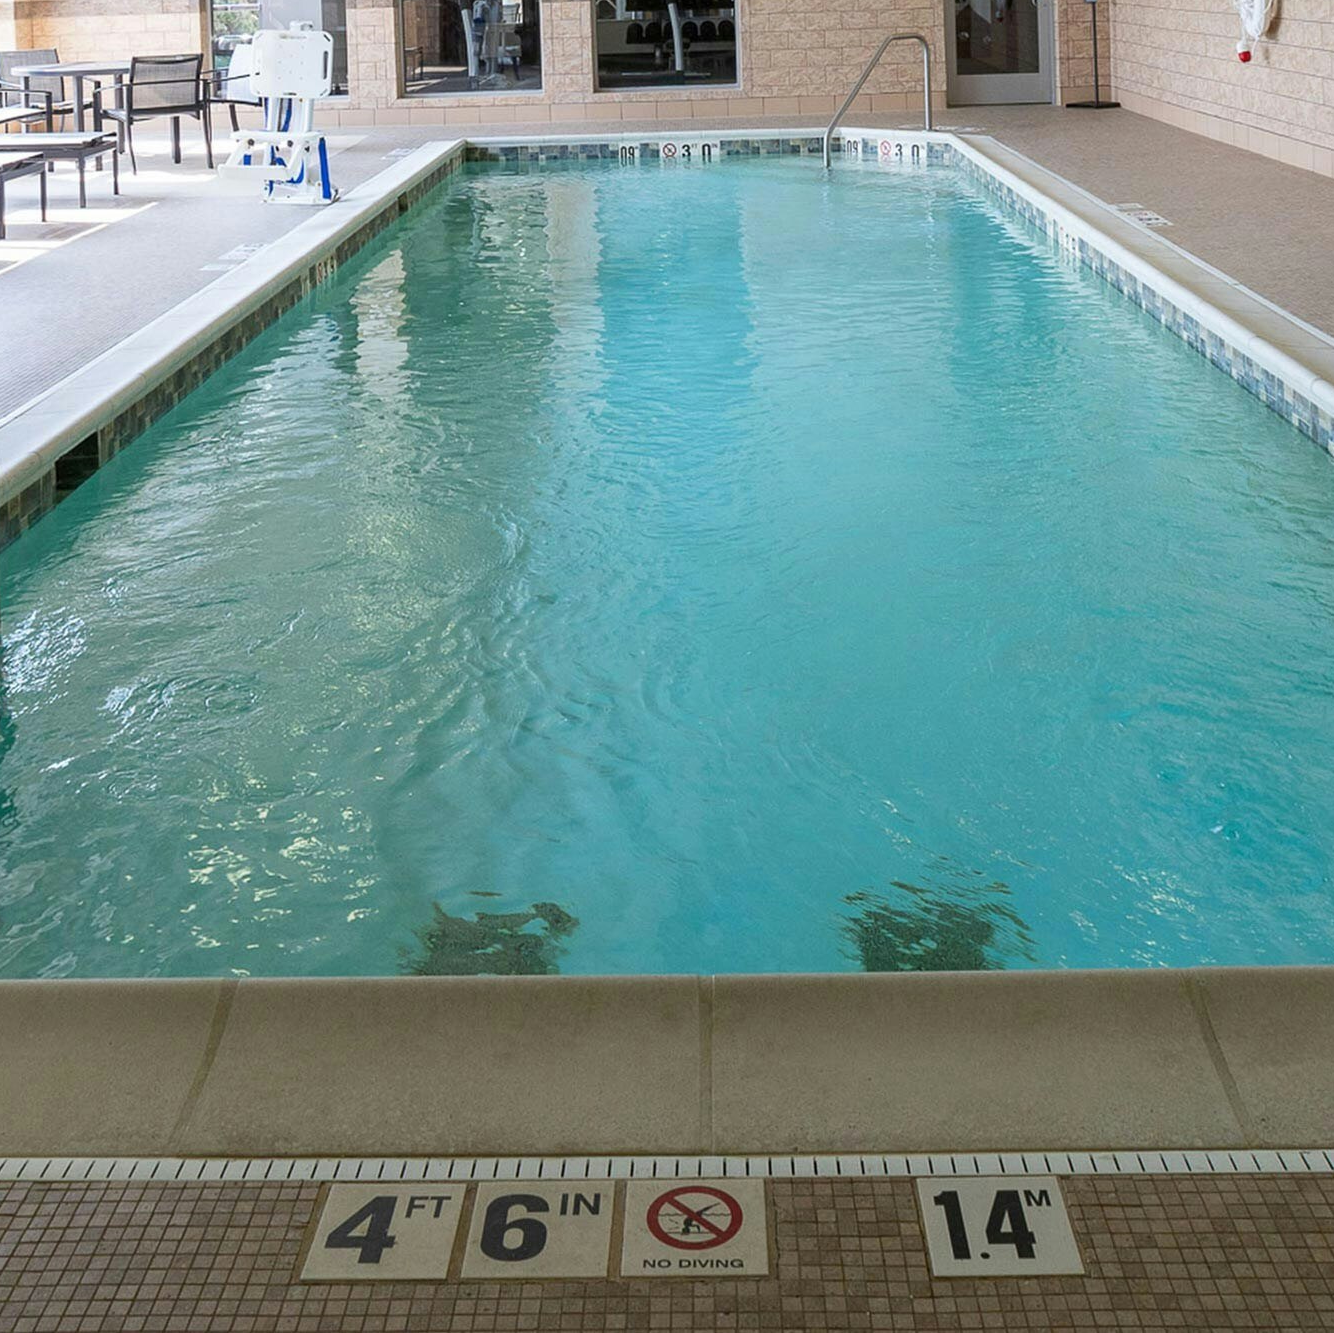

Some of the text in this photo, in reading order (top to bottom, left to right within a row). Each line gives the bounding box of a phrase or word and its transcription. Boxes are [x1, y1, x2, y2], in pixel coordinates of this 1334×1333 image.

[324, 1192, 602, 1264] 4 FT 6 IN
[642, 1258, 745, 1269] NO DIVING
